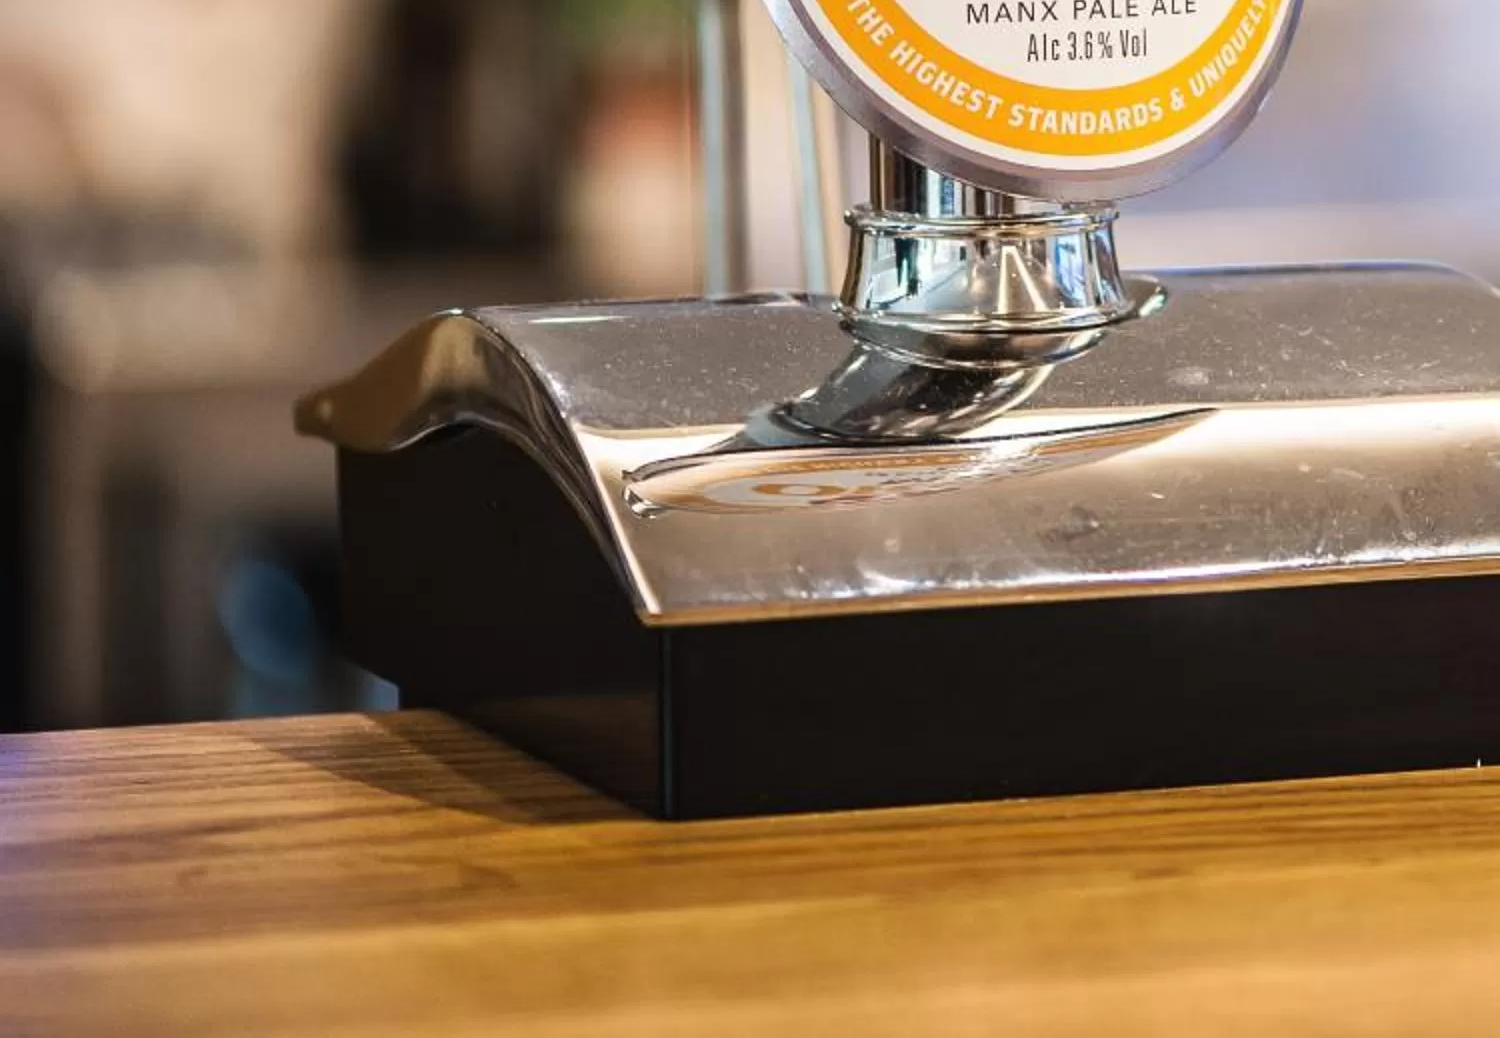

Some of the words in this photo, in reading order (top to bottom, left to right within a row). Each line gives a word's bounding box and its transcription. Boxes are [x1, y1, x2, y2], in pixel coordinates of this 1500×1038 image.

[966, 0, 1059, 24] MANX
[1027, 33, 1060, 62] Alc
[1119, 28, 1147, 58] Vol
[889, 40, 1004, 120] HIGHEST
[1008, 97, 1164, 135] STANDARDS
[1170, 87, 1186, 111] &
